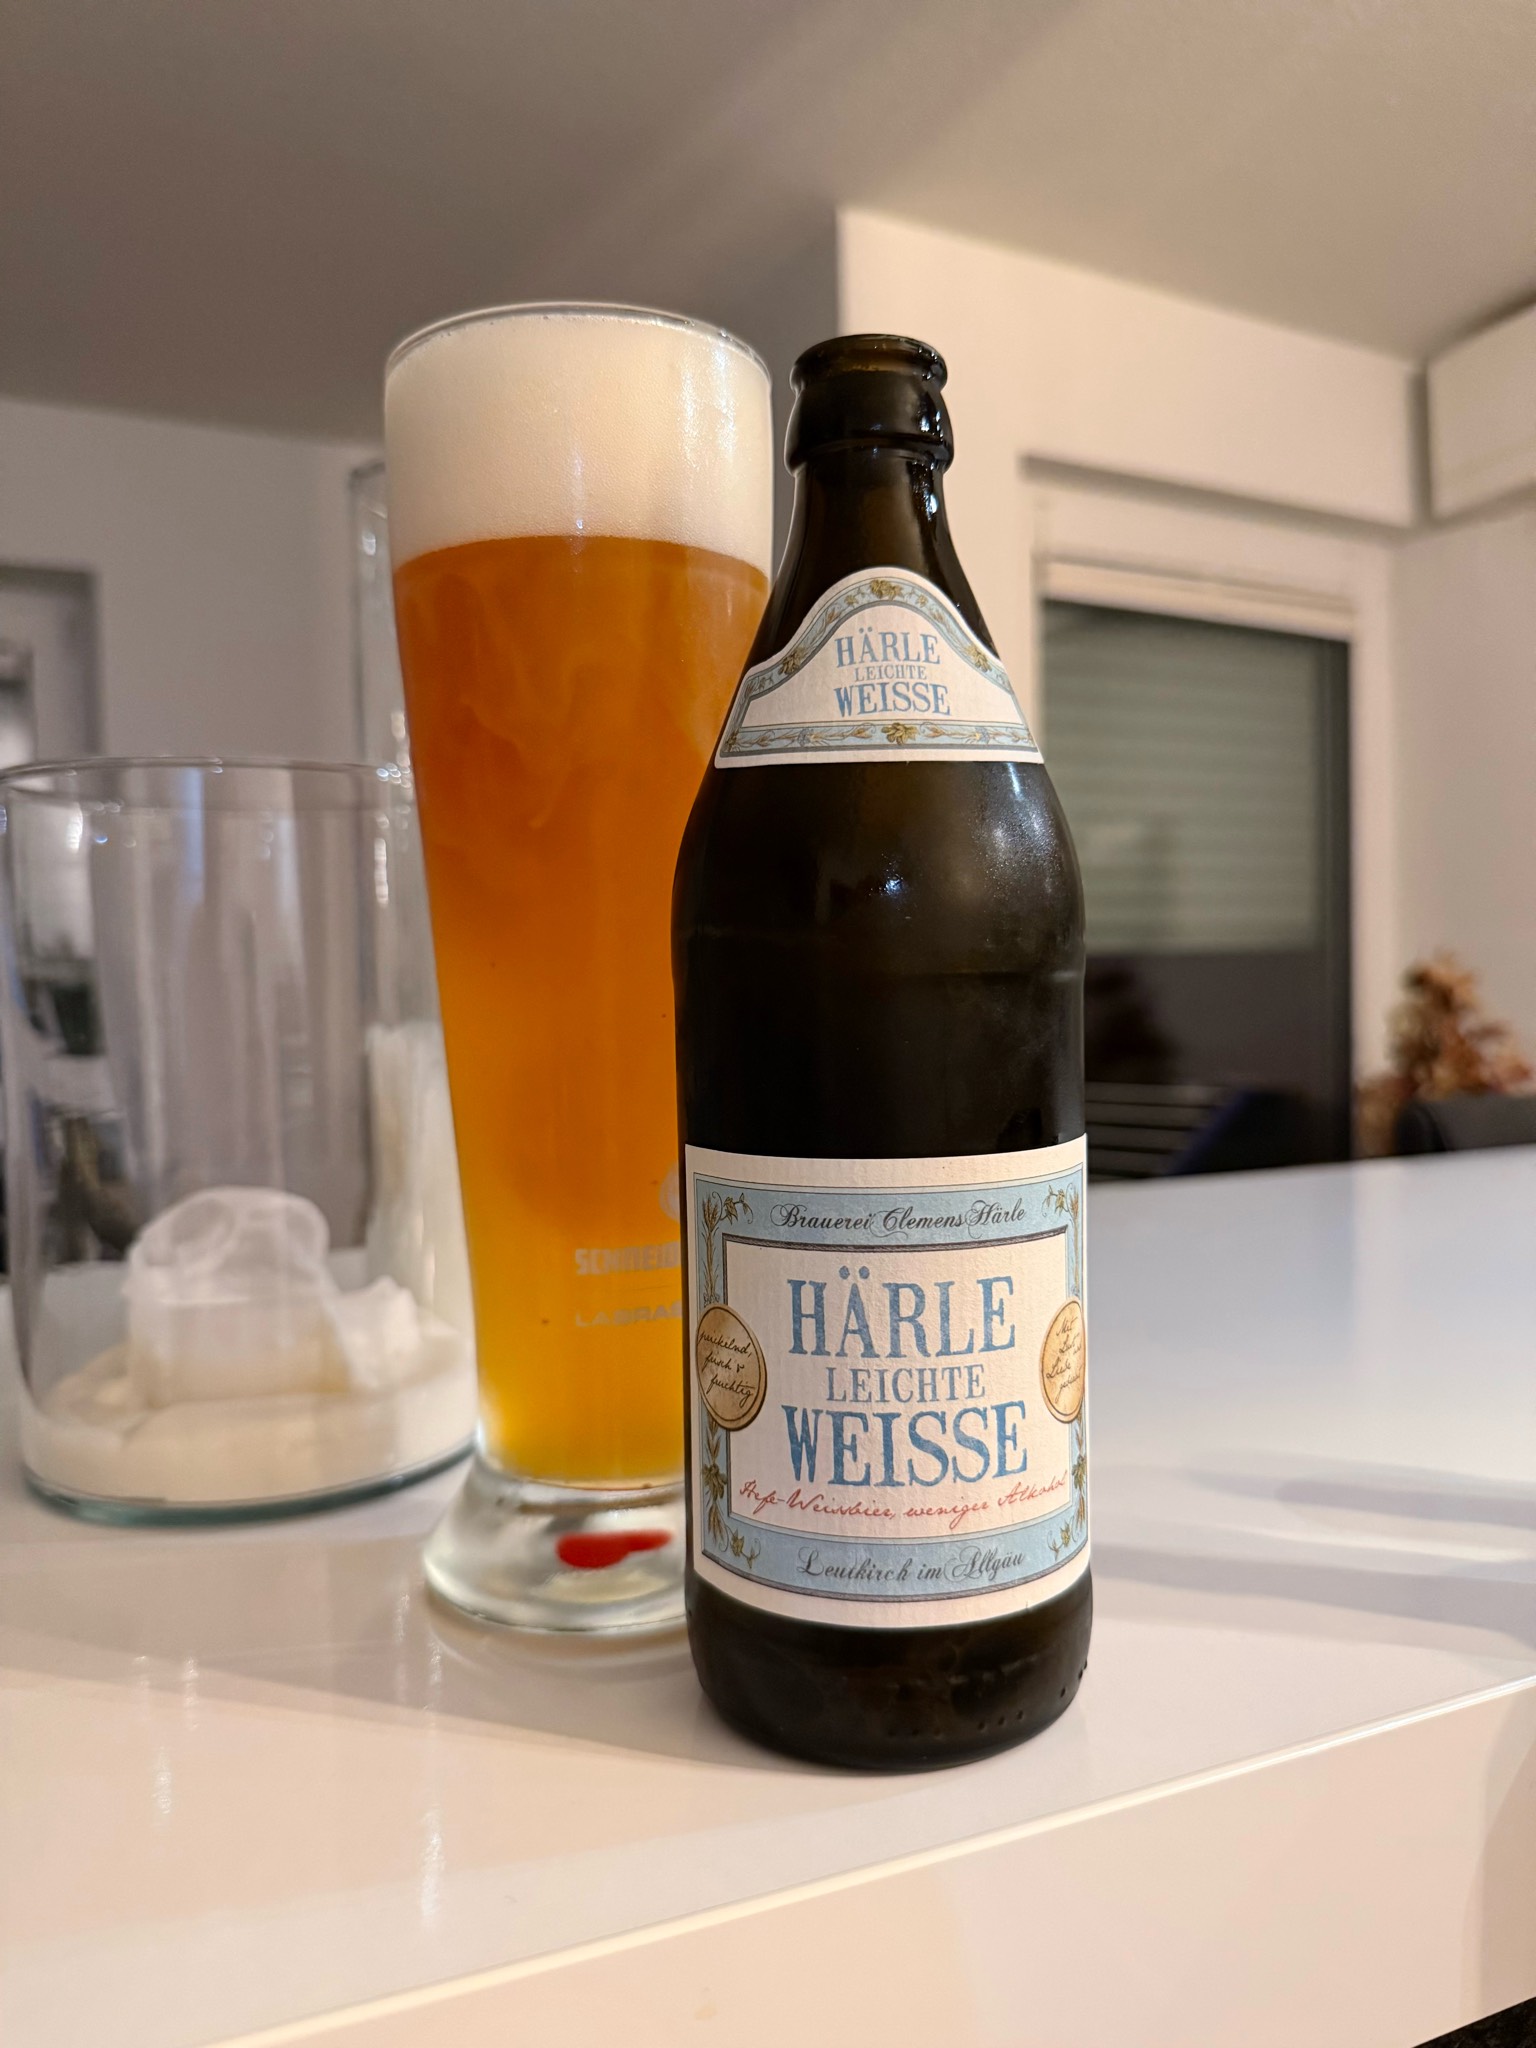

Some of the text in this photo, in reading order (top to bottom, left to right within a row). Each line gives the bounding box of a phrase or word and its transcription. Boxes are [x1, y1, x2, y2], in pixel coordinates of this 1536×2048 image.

[834, 626, 941, 669] HÄRLE
[854, 664, 927, 682] LEICHTE
[833, 681, 951, 717] WEISSE
[870, 1205, 965, 1238] Clemens
[965, 1198, 1026, 1239] Härle
[787, 1265, 1016, 1358] HÄRLE
[826, 1363, 985, 1403] LEICHTE
[781, 1400, 1028, 1488] WEISSE
[903, 1498, 989, 1529] weniger
[997, 1470, 1068, 1507] Alkohol
[796, 1546, 1025, 1581] Leutkirch im Allgäu
